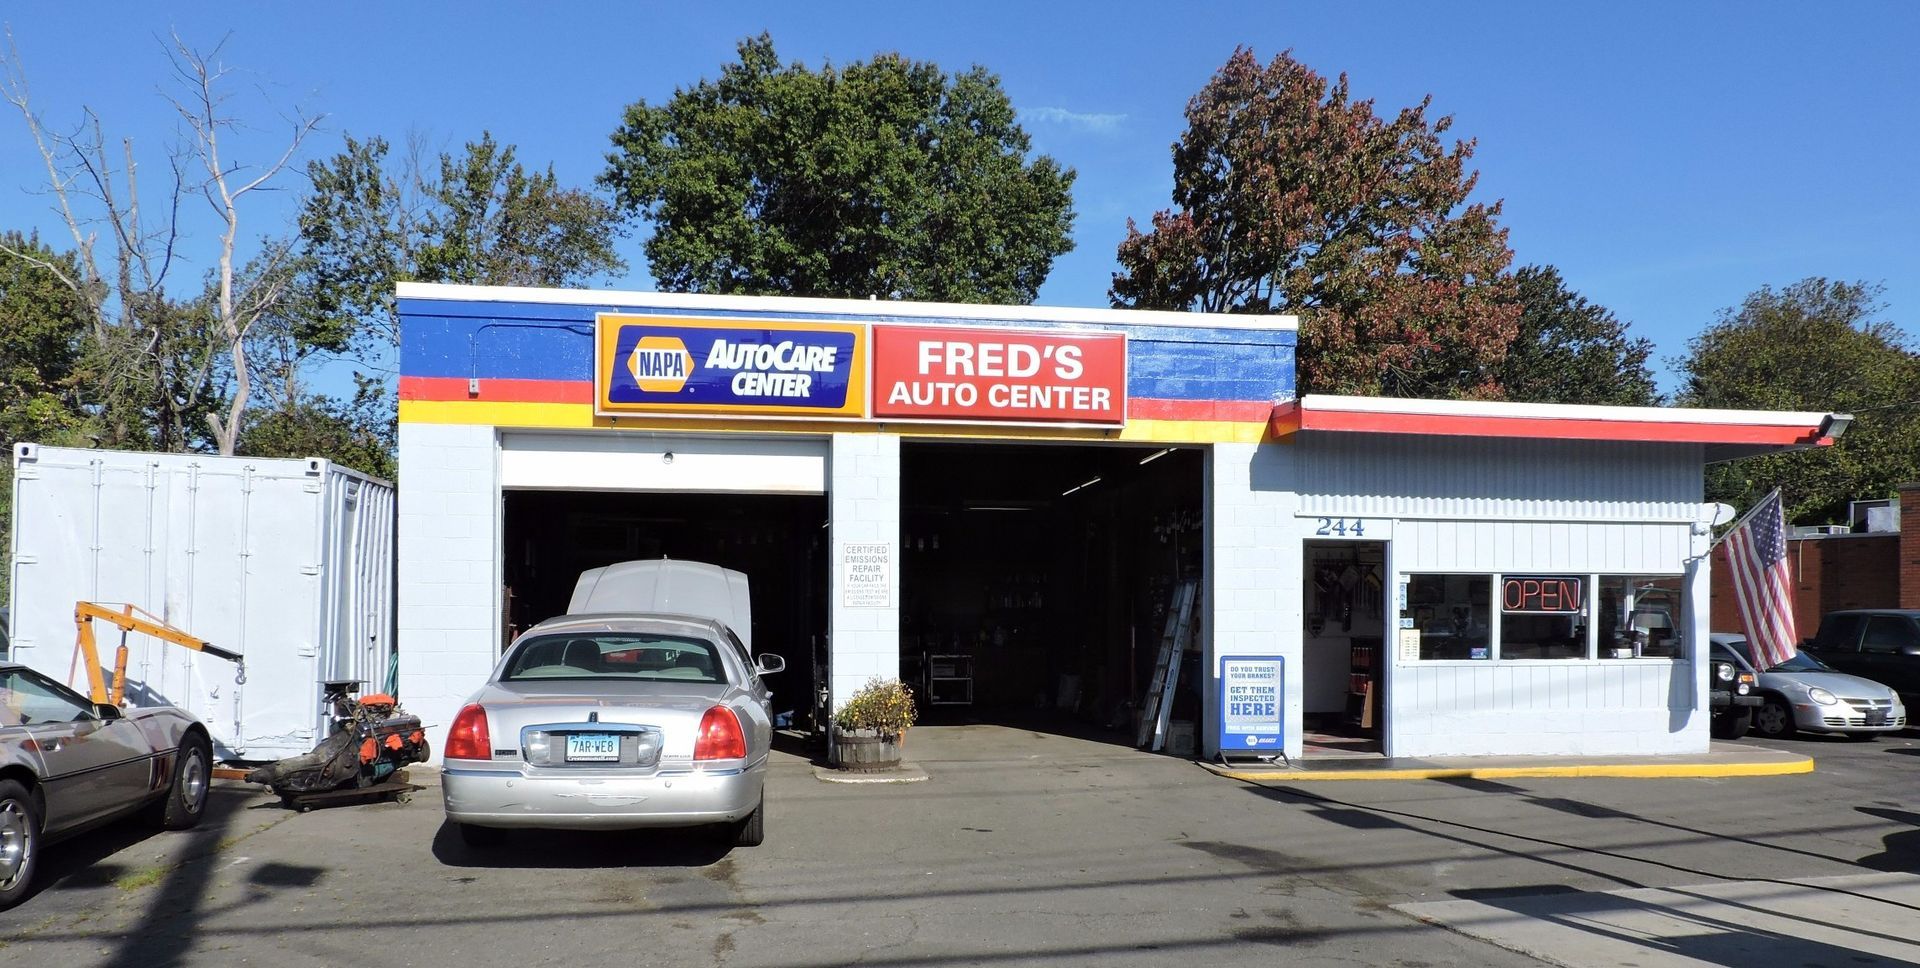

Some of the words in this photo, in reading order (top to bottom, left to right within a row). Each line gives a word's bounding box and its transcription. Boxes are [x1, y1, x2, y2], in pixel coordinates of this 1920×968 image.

[640, 352, 684, 377] NAPA
[918, 341, 1083, 380] FRED'S
[731, 372, 811, 397] CENTER
[888, 382, 978, 408] AUTO
[988, 384, 1110, 410] CENTER
[1316, 517, 1365, 536] 244
[845, 555, 888, 564] EMISSIONS
[846, 546, 887, 554] CERTIFIED
[849, 574, 884, 582] FACILITY
[1504, 580, 1577, 610] OPEN
[1230, 686, 1248, 694] GET
[1250, 686, 1274, 694] THEM
[1230, 703, 1275, 716] HERE
